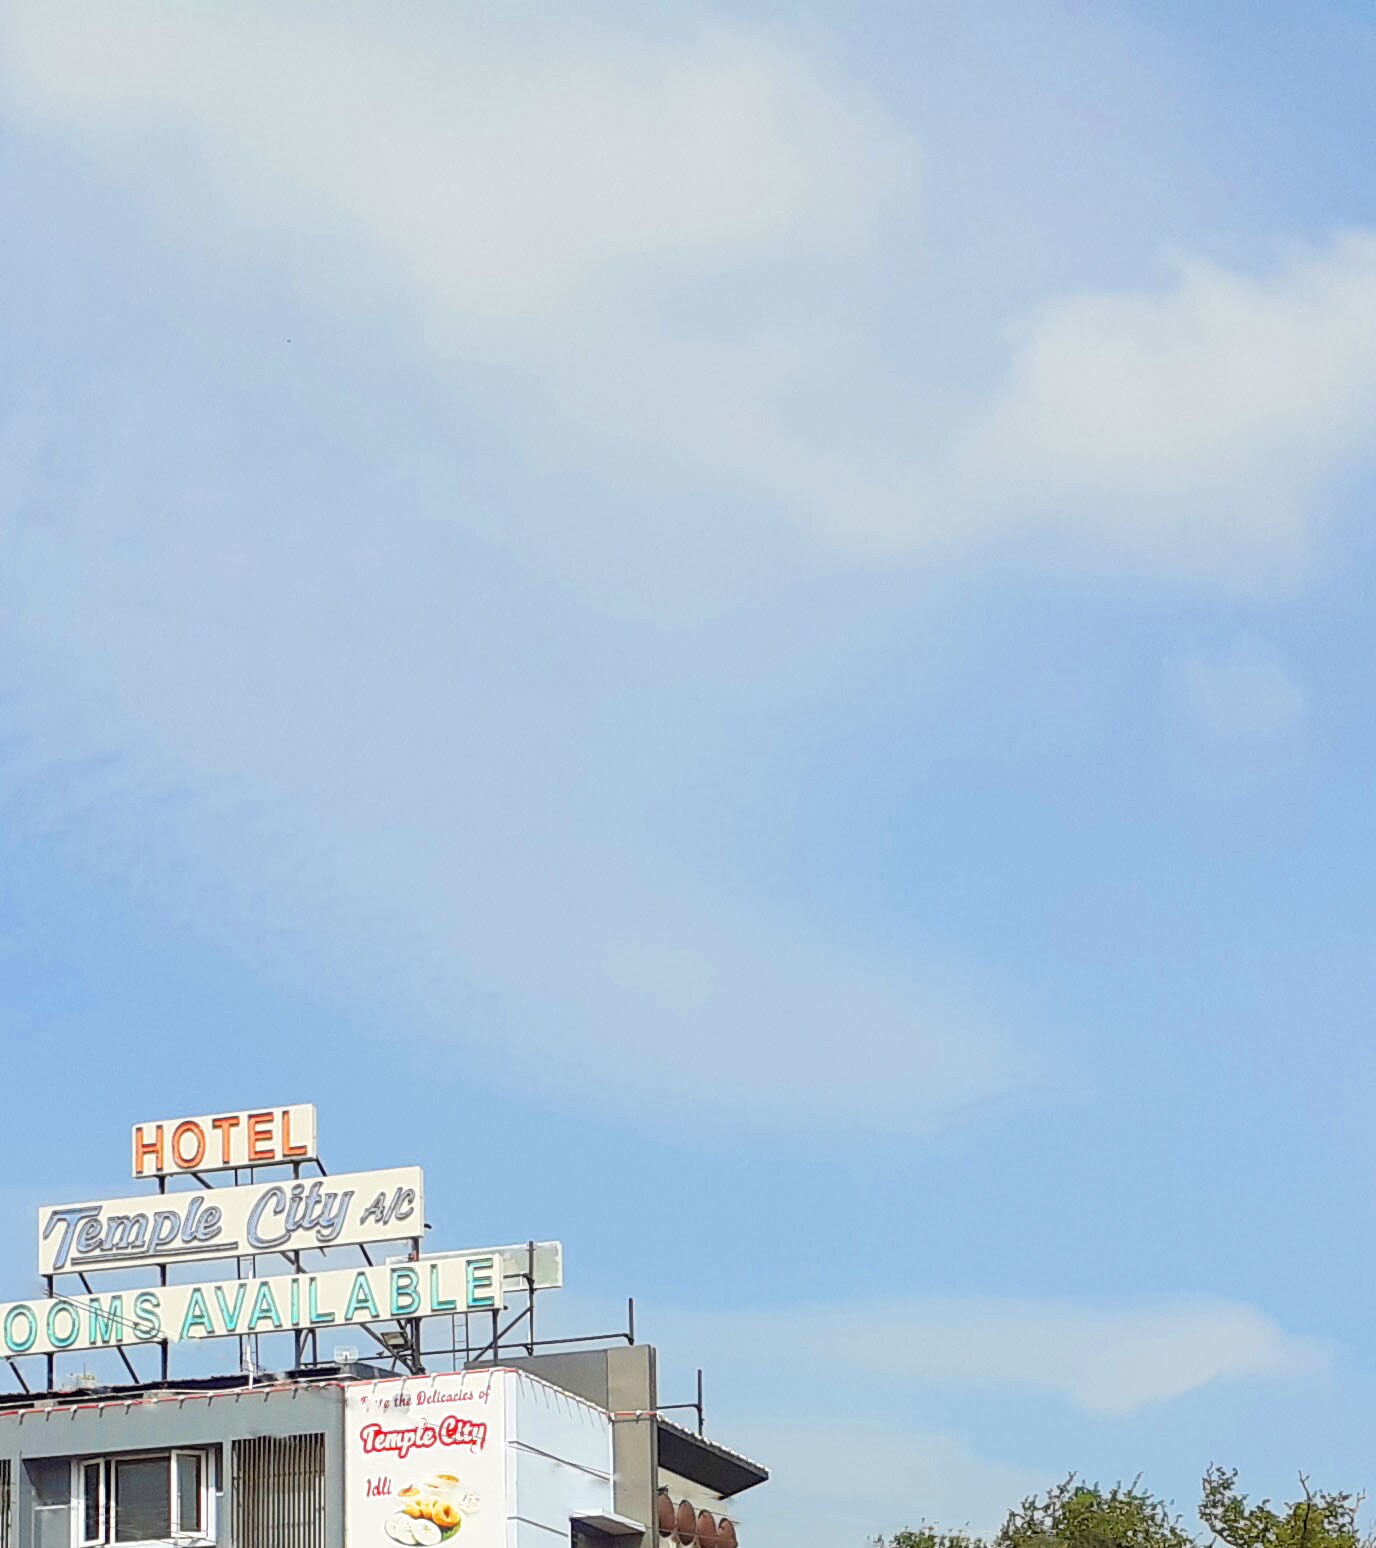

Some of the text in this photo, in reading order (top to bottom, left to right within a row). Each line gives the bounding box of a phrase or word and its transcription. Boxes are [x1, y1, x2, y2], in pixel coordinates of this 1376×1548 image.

[135, 1111, 308, 1175] HOTEL
[43, 1183, 414, 1269] Temple City A/C
[181, 1258, 494, 1342] AVAILABLE
[416, 1389, 473, 1406] Delicacies
[478, 1385, 491, 1404] of
[360, 1415, 487, 1458] Temple City
